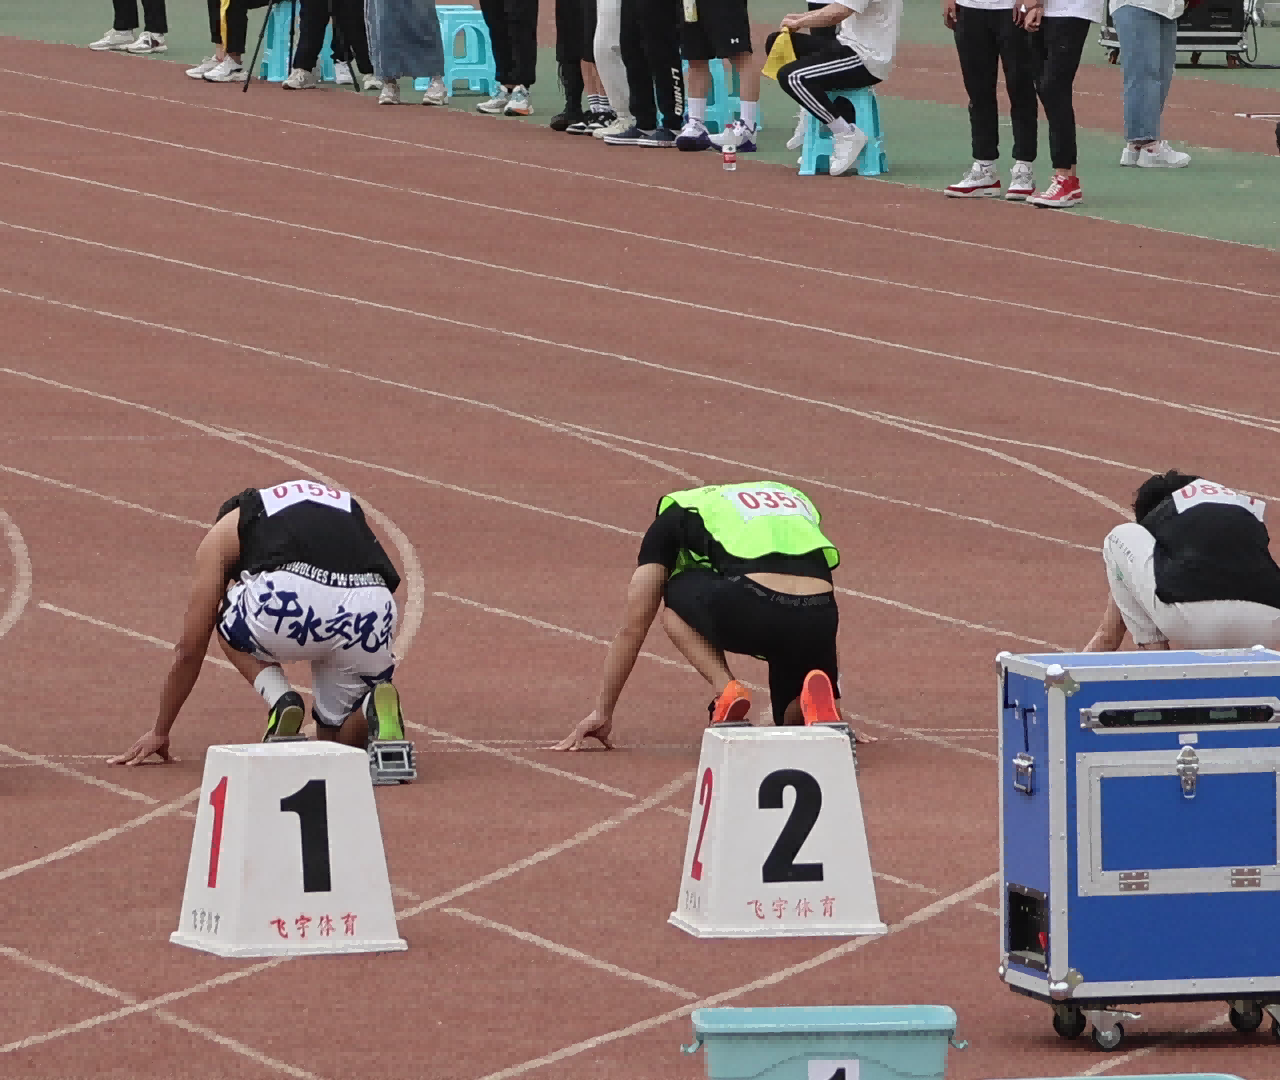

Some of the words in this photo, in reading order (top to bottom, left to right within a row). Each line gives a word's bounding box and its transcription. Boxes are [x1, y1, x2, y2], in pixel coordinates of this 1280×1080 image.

[1180, 484, 1256, 506] 08
[208, 775, 228, 889] 1
[279, 778, 332, 893] 1
[690, 766, 714, 882] 2
[756, 768, 825, 884] 2
[270, 911, 358, 939] 飞宇体育
[747, 895, 836, 919] 飞宇体育
